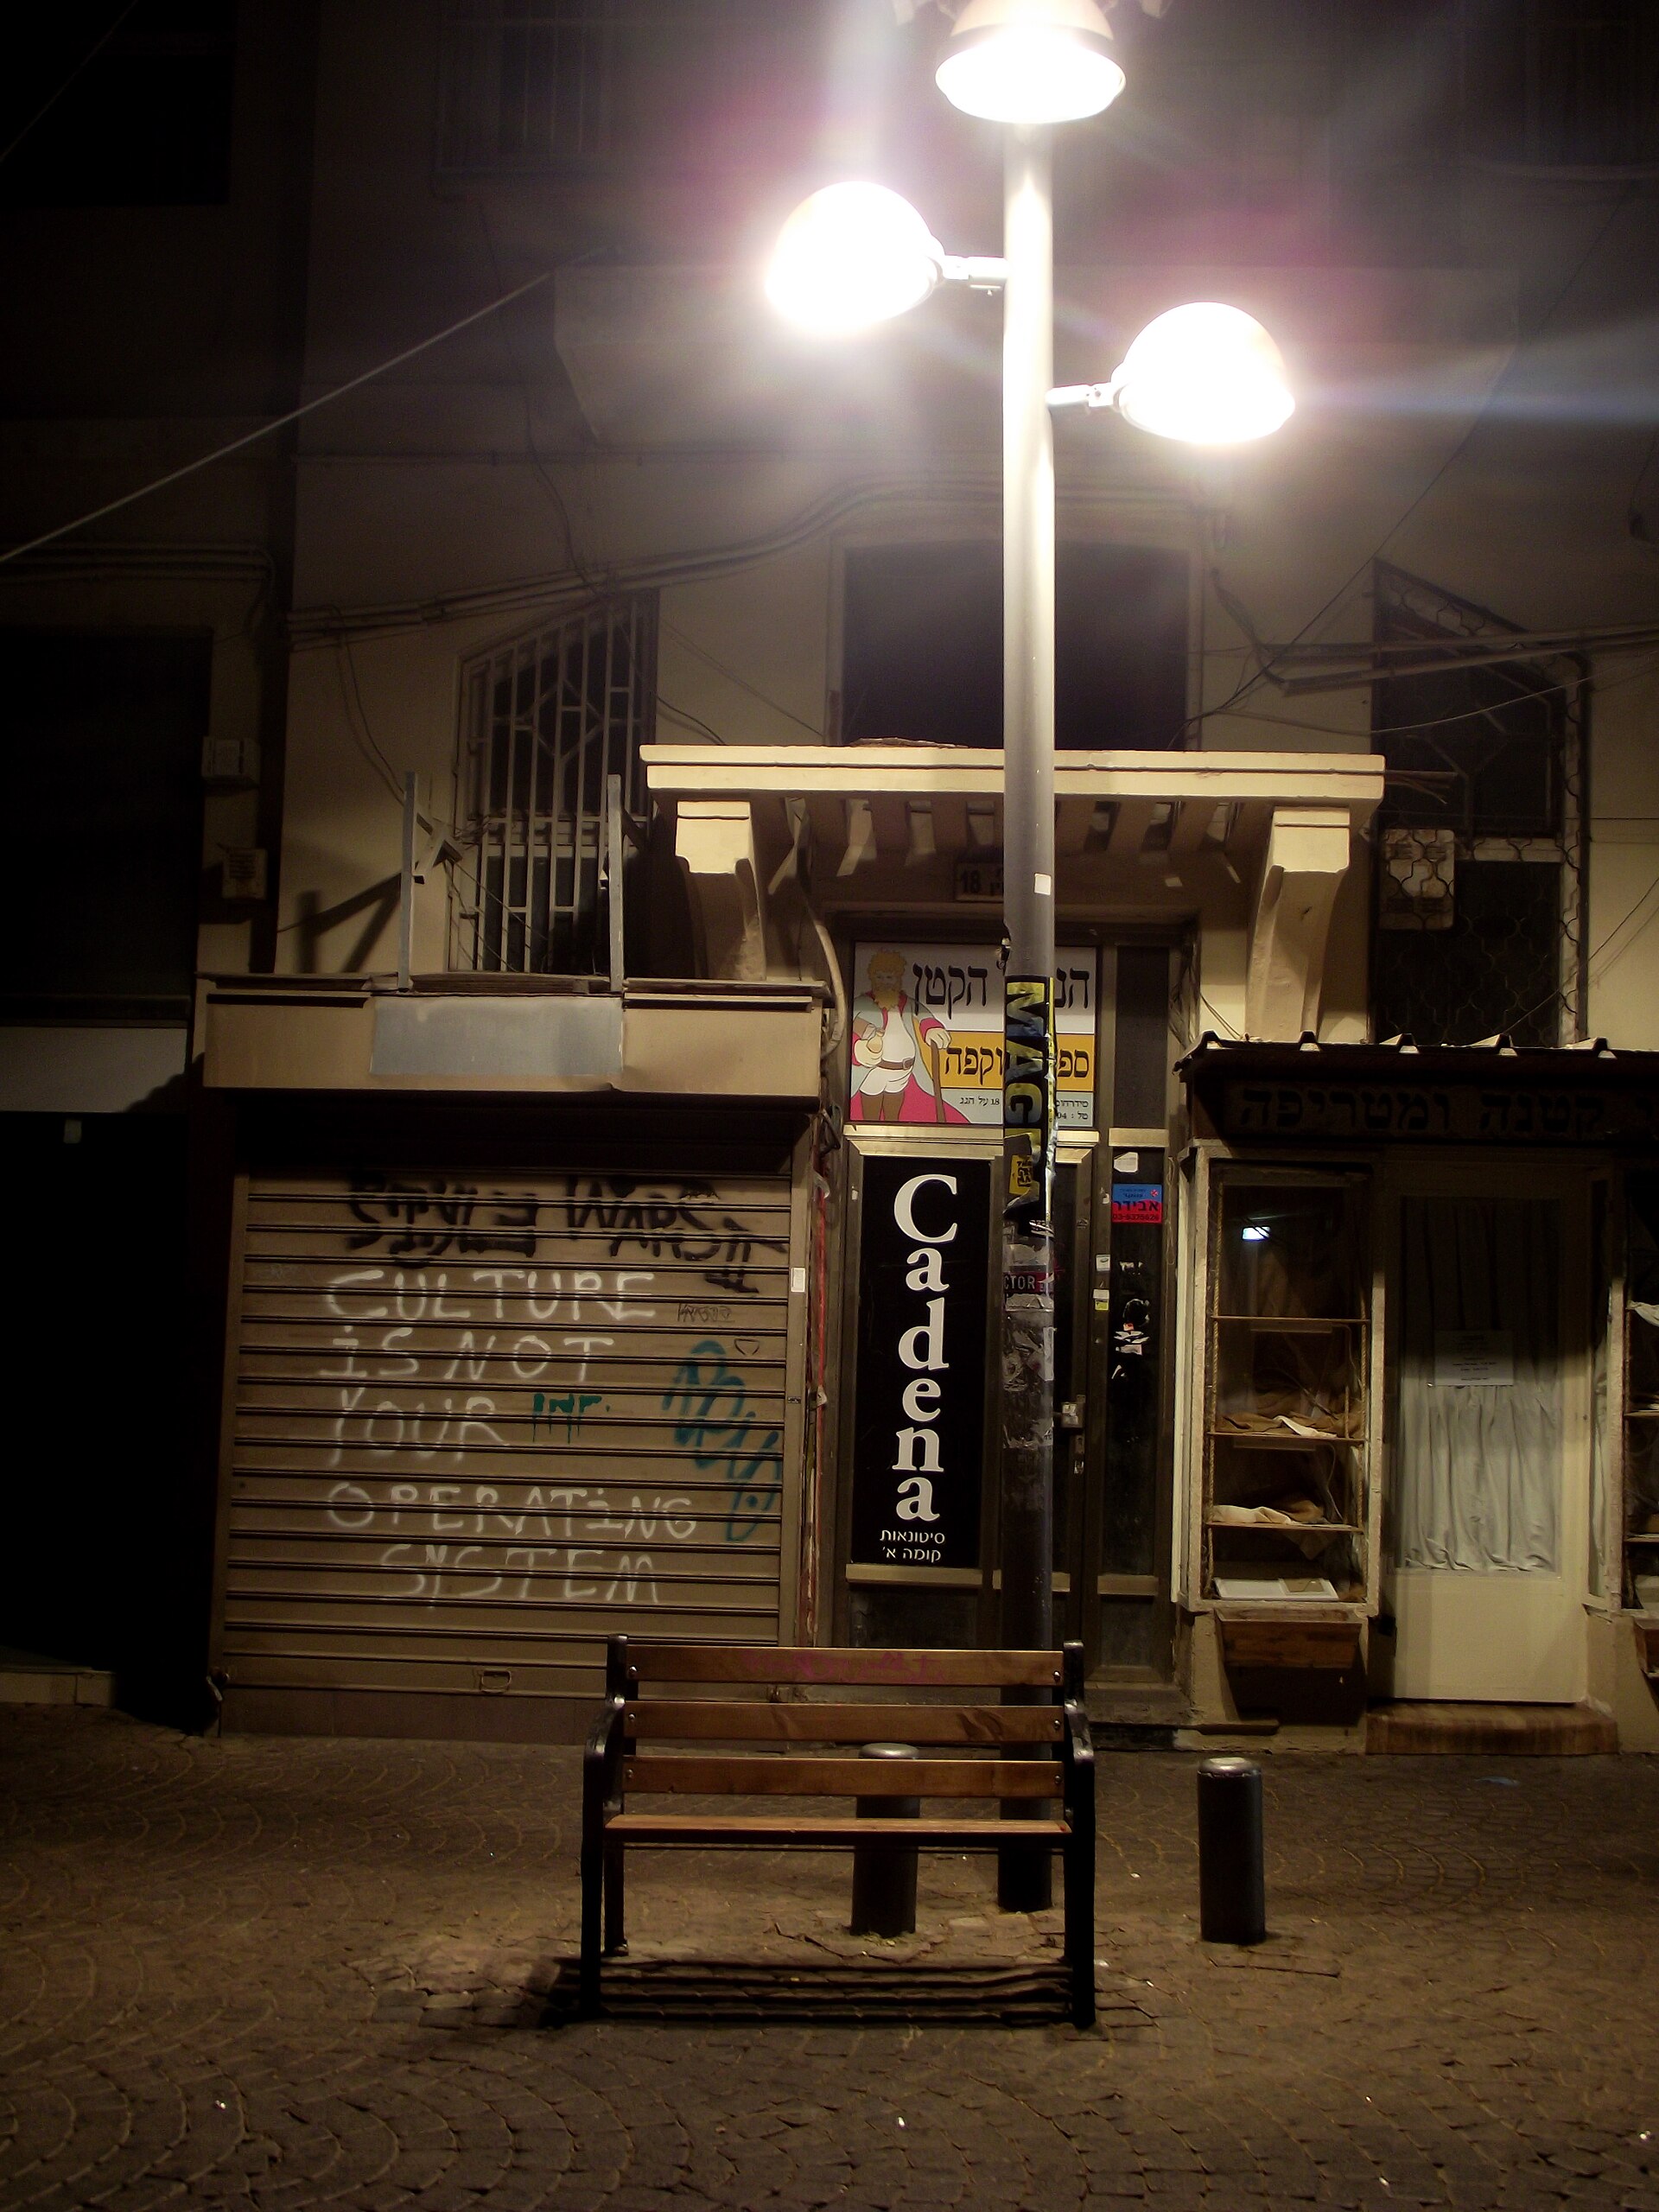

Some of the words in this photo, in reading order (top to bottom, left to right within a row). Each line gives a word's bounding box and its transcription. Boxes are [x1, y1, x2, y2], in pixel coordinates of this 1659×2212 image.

[912, 963, 988, 1020] הקטן
[1055, 967, 1090, 1009] הנ
[1058, 1048, 1090, 1078] ספ
[977, 1095, 989, 1107] על
[990, 1097, 1001, 1106] 18
[1479, 1093, 1605, 1141] קטנה
[325, 1268, 658, 1321] CULTURE
[444, 1330, 615, 1383] NOT
[892, 1173, 958, 1522] Cadena
[327, 1384, 511, 1467] YOUR
[879, 1529, 945, 1544] סיטונאות
[902, 1548, 942, 1563] קומה
[379, 1542, 659, 1609] SYSTEM
